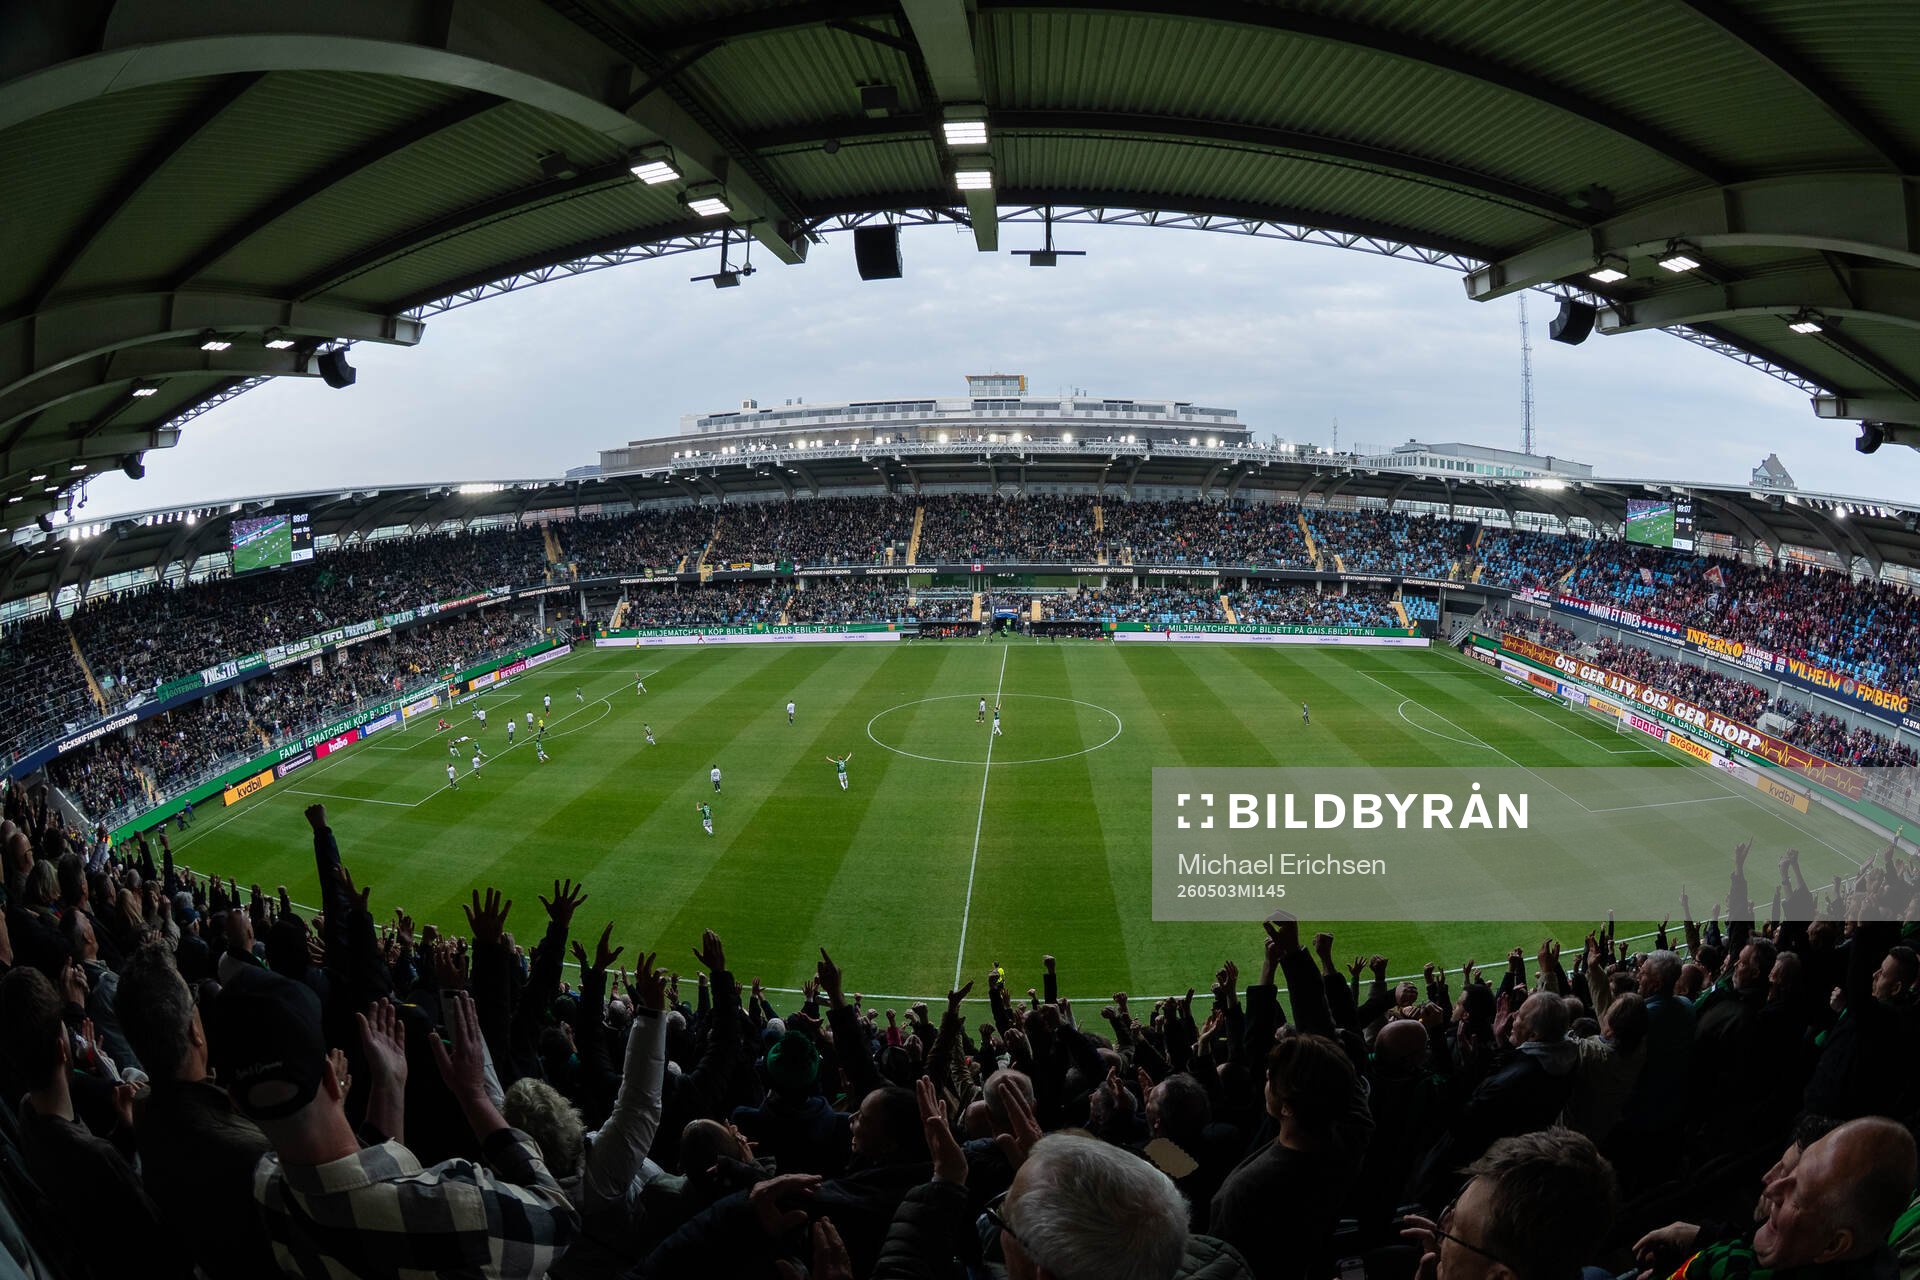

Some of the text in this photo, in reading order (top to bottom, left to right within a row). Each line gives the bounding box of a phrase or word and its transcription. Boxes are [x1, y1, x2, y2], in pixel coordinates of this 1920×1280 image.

[1107, 566, 1134, 574] GÖTEBORG
[1191, 568, 1220, 576] GÖTEBORG
[1588, 603, 1642, 629] AMOR ET FIDES
[709, 627, 724, 635] KÖP
[1240, 623, 1257, 633] KÖP
[1259, 625, 1292, 634] BILJETT
[1294, 625, 1305, 634] PÅ
[286, 641, 310, 655] GAIS
[321, 630, 344, 644] TIFO
[1471, 650, 1496, 666] XL-BYGG
[1745, 645, 1773, 662] BALDERS
[500, 664, 525, 679] BEVEGO
[1789, 658, 1841, 692] WILHELM
[1856, 684, 1909, 714] FRIBERG
[1555, 655, 1577, 674] ÖIS
[1580, 665, 1606, 686] GER
[1611, 676, 1636, 699] LIV,
[1641, 686, 1668, 710] ÖIS
[1674, 702, 1706, 729] GER
[1710, 717, 1762, 750] HOPP
[353, 711, 369, 728] KÖP
[1630, 715, 1663, 740] CRAMO
[1902, 717, 1910, 726] 12
[58, 713, 139, 753] DÄCKSKIFTARNA GÖTEBORG
[329, 738, 348, 753] habo
[1670, 735, 1710, 761] BYGGMAX
[237, 777, 263, 799] kvdbil
[1768, 782, 1796, 806] kvdbil
